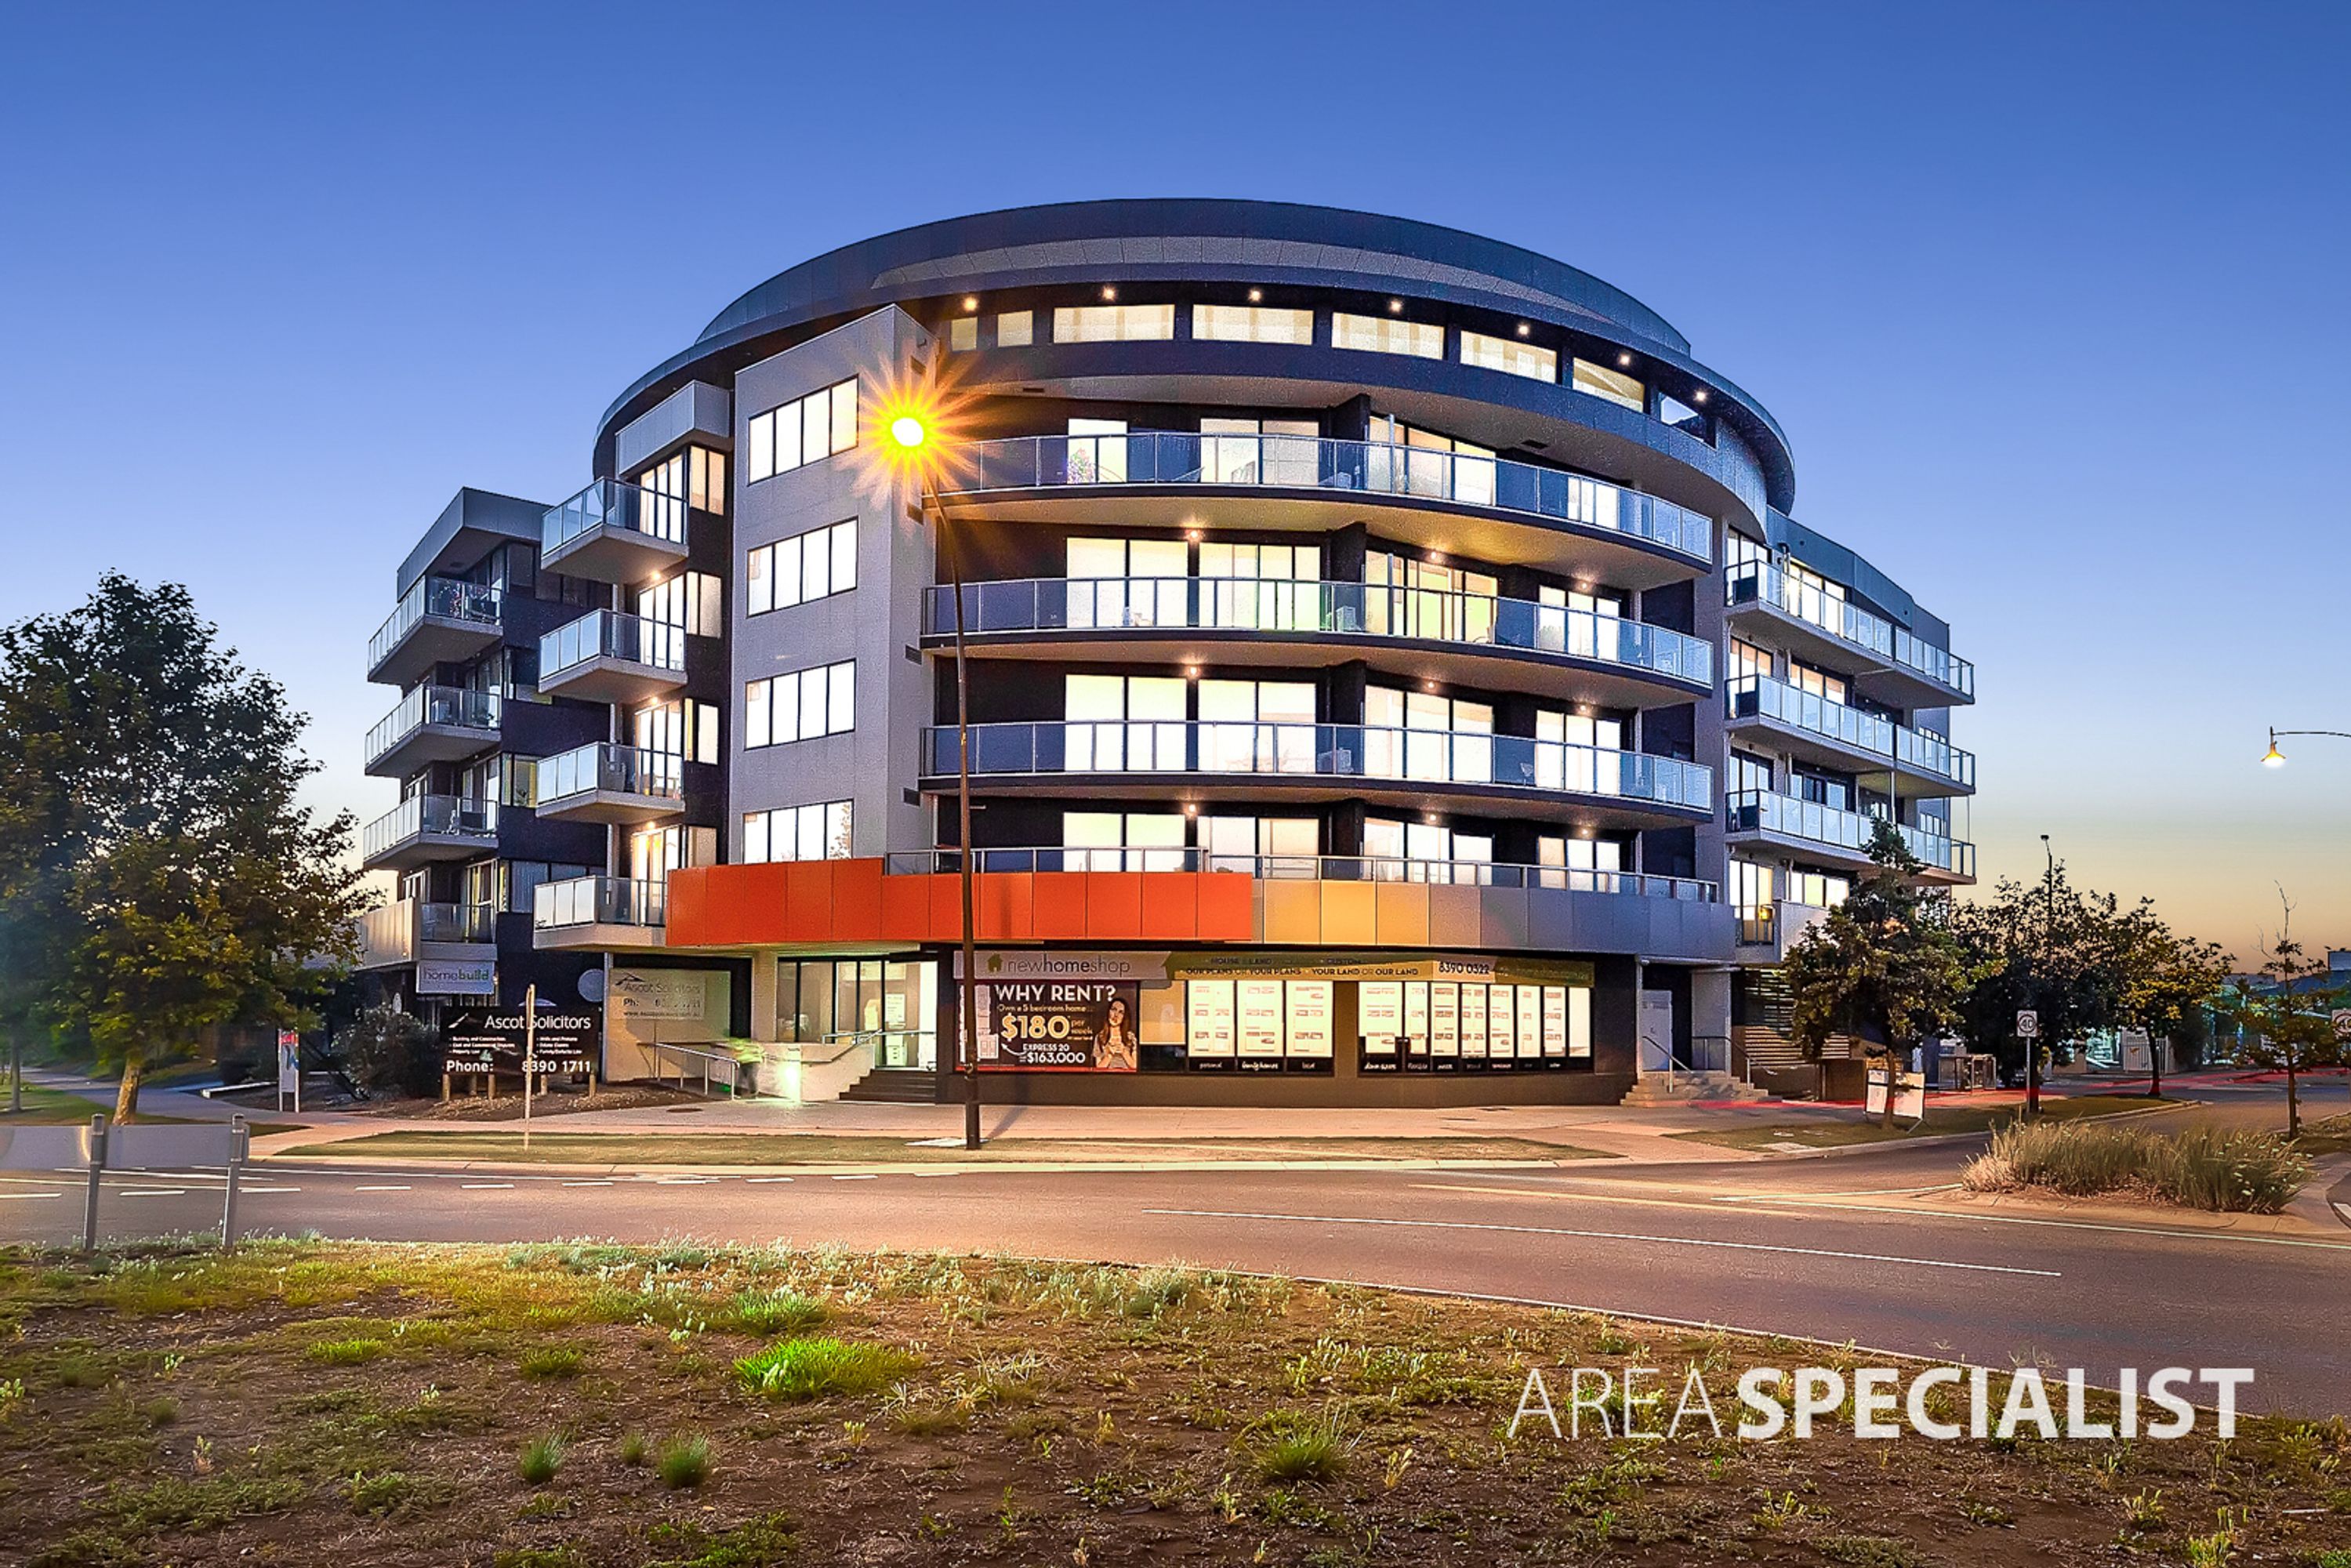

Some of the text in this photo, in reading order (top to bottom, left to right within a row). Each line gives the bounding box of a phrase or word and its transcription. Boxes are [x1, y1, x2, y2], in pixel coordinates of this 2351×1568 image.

[1008, 953, 1130, 977] newhomeshop
[1466, 964, 1490, 975] 0322
[423, 967, 489, 981] homebuild
[995, 985, 1116, 1002] WHY RENT?
[996, 1004, 1016, 1012] Own
[1030, 1004, 1065, 1012] bedroom
[484, 1014, 592, 1029] Ascot Solicitors
[446, 1060, 494, 1073] Phone:
[561, 1060, 591, 1073] 1711
